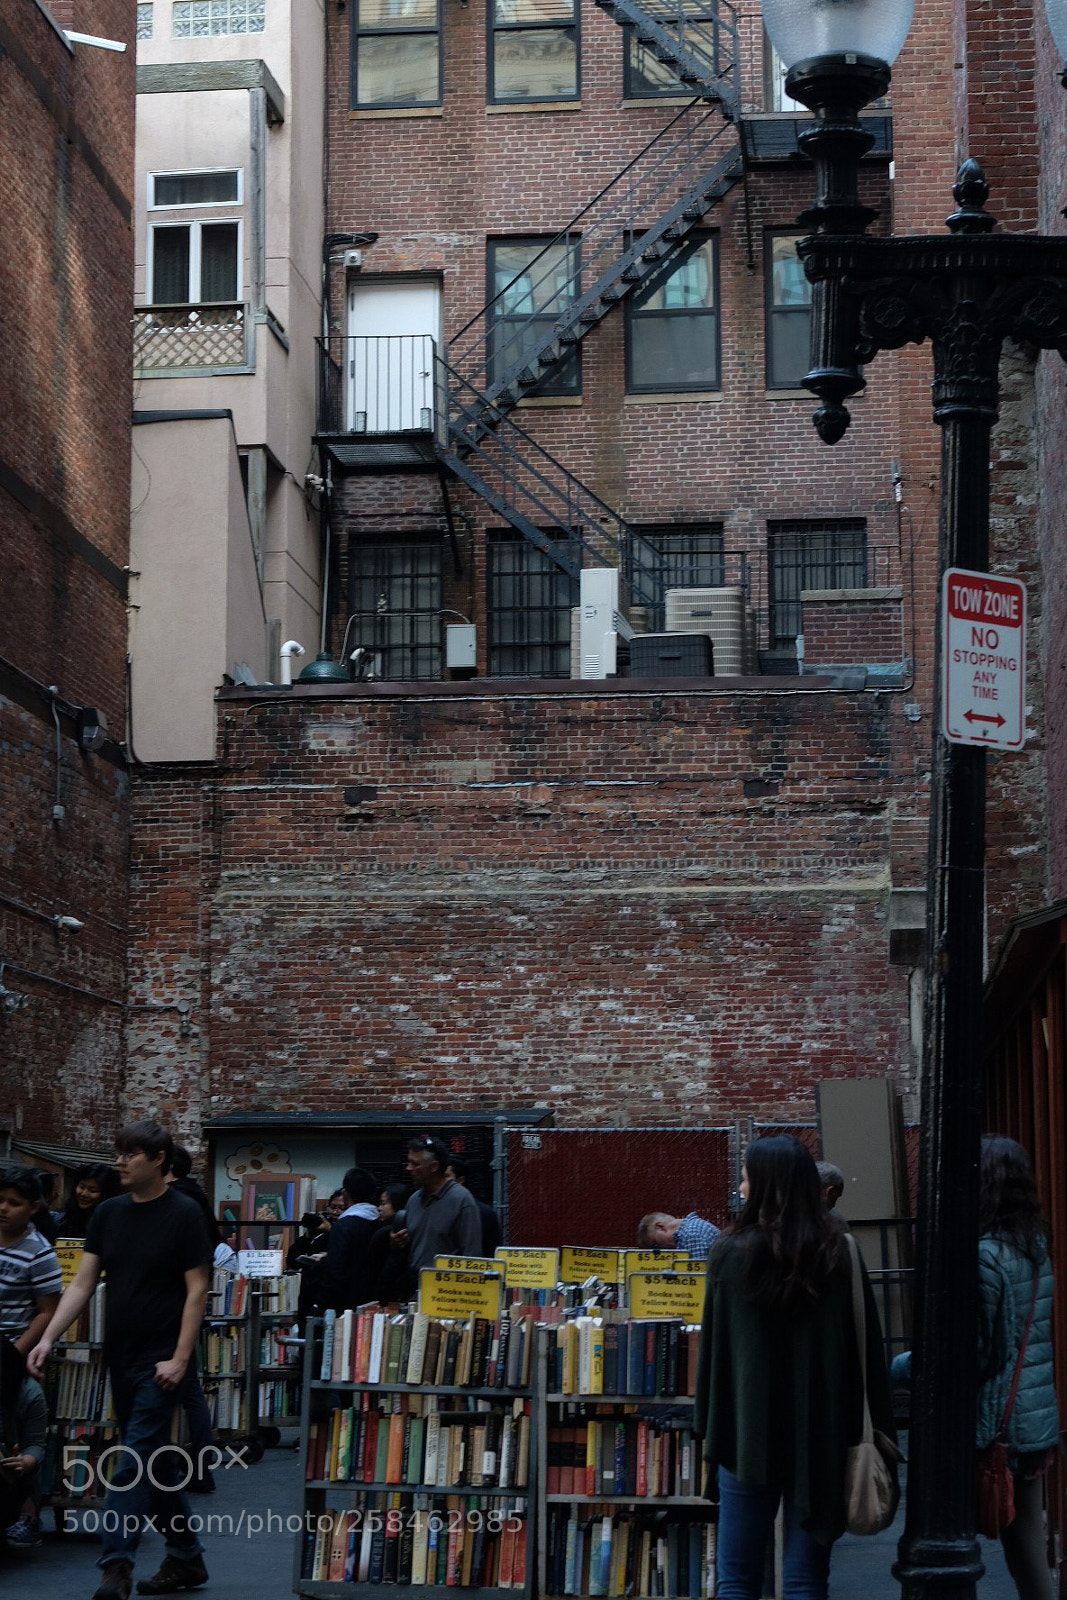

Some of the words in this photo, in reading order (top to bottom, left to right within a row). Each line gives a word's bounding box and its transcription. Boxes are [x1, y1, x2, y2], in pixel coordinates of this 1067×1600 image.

[952, 585, 983, 613] TOW
[983, 590, 1019, 620] ZONE
[971, 626, 1000, 650] NO
[953, 649, 1017, 671] STOPPING
[973, 670, 997, 684] ANY
[971, 685, 999, 701] TIME
[506, 1249, 519, 1258] $5
[522, 1250, 547, 1259] Each
[572, 1249, 584, 1257] $5
[586, 1250, 608, 1259] Each
[637, 1253, 651, 1261] $5
[654, 1252, 678, 1261] Each
[448, 1259, 462, 1269] $5
[465, 1260, 493, 1270] Each
[687, 1263, 701, 1272] $5
[435, 1272, 451, 1282] $5
[455, 1274, 487, 1285] Each
[645, 1275, 661, 1284] $5
[665, 1276, 697, 1286] Each
[438, 1287, 462, 1295] Books
[648, 1290, 672, 1298] Books
[431, 1295, 457, 1303] Yellow
[459, 1297, 488, 1306] Sticker
[669, 1300, 700, 1308] Sticker
